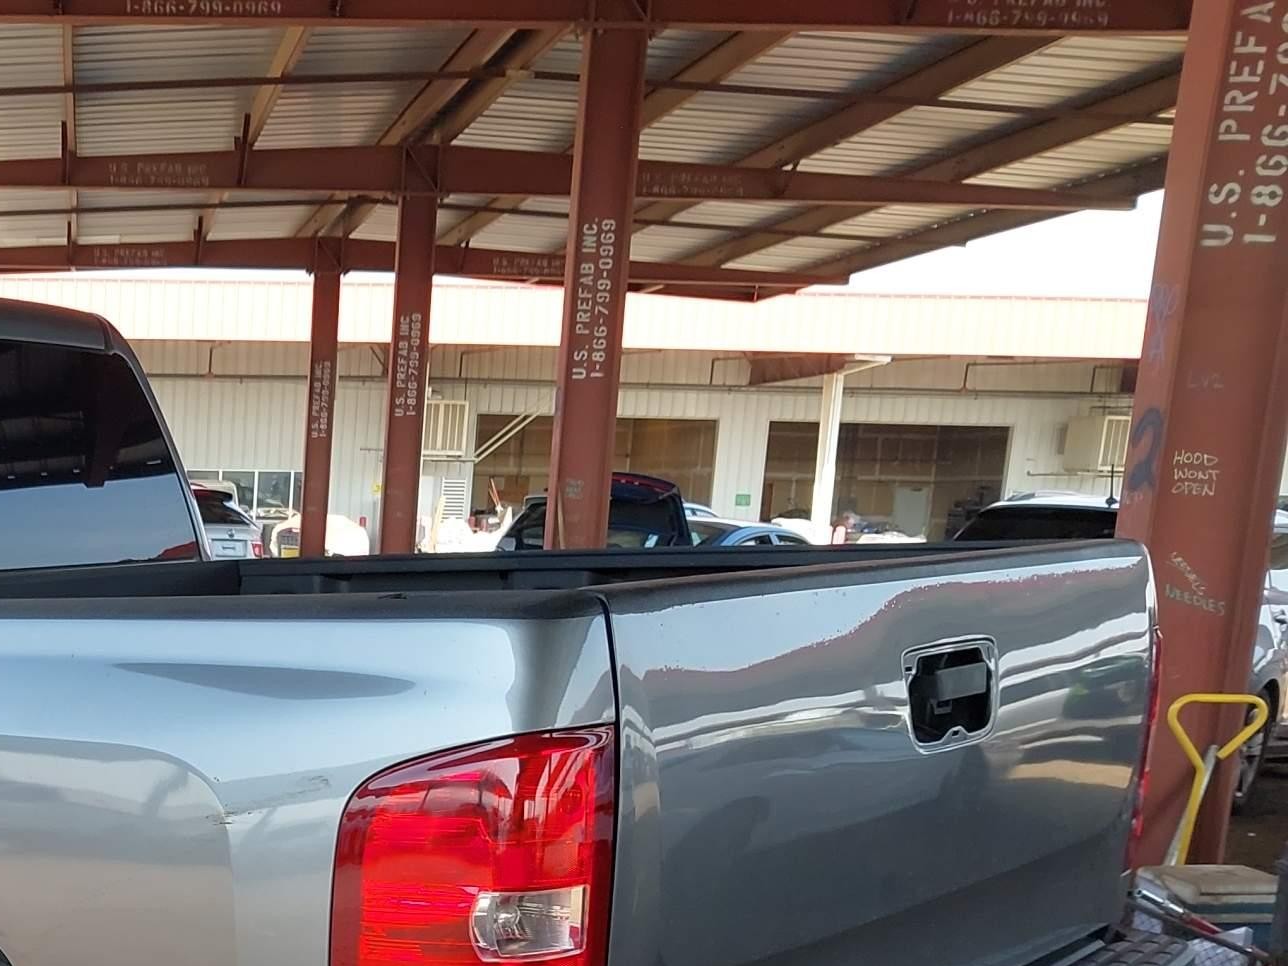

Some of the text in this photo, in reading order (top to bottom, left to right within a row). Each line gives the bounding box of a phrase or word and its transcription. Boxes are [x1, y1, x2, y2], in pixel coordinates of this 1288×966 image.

[1200, 168, 1245, 247] U.S.
[572, 217, 599, 380] U.S. PREFAB INC.
[591, 219, 616, 377] 1-866-799-0969
[396, 341, 409, 388] PREFAB
[406, 312, 421, 416] 1-866-799-0969
[394, 394, 406, 417] U.S.
[1173, 449, 1219, 466] HOOD
[1173, 468, 1220, 481] WONT
[1171, 481, 1216, 496] OPEN
